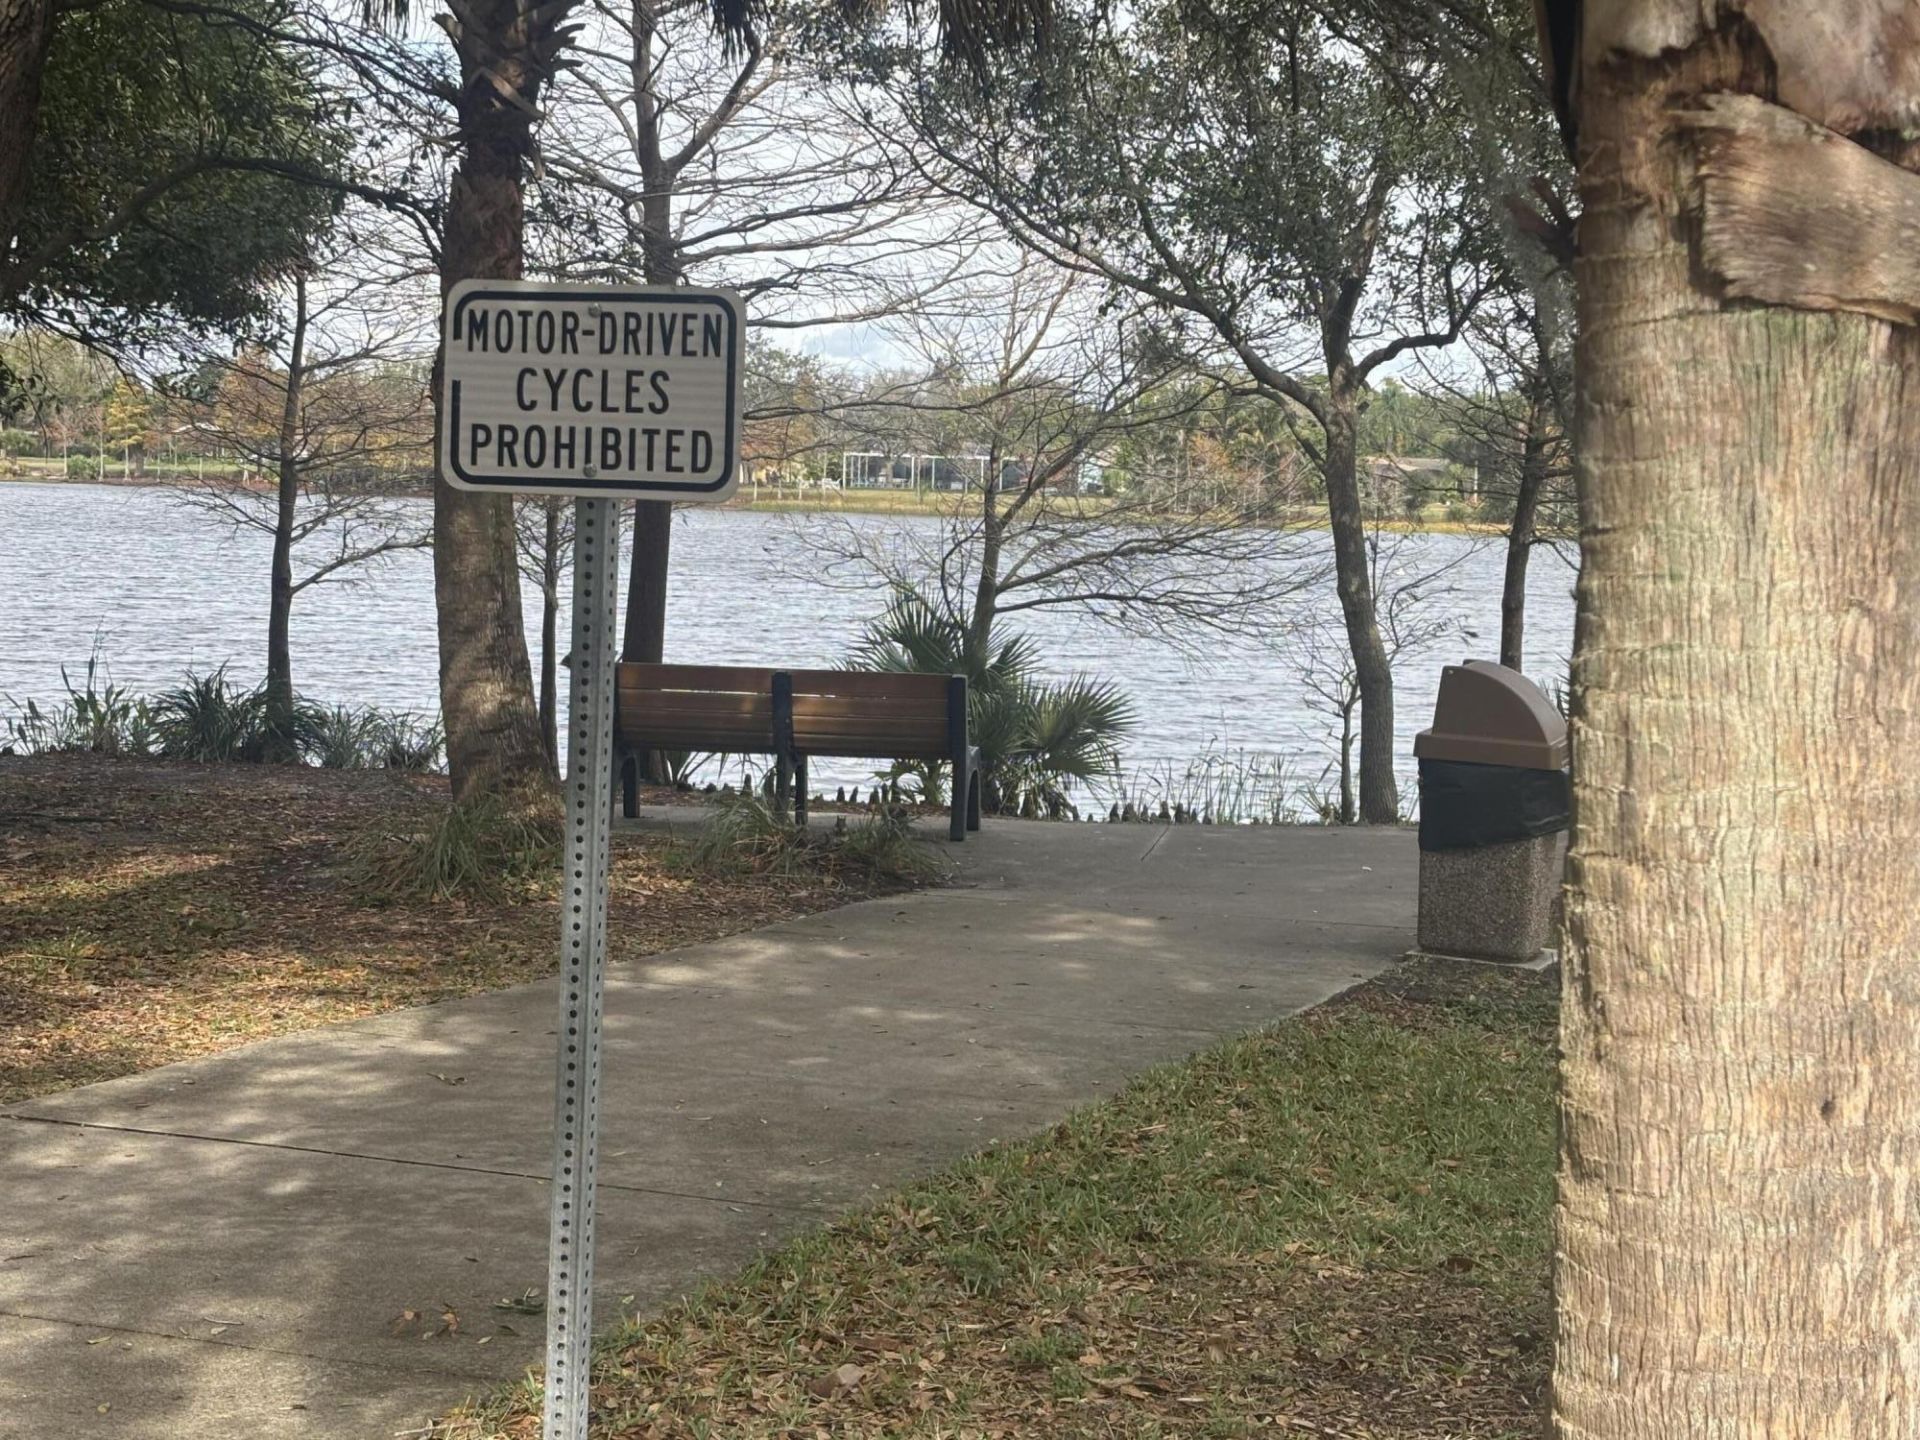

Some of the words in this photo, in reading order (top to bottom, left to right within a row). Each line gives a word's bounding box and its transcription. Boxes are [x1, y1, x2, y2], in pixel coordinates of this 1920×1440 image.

[468, 309, 722, 357] MOTOR-DRIVEN
[517, 367, 670, 414] CYCLES
[470, 423, 713, 474] PROHIBITED
